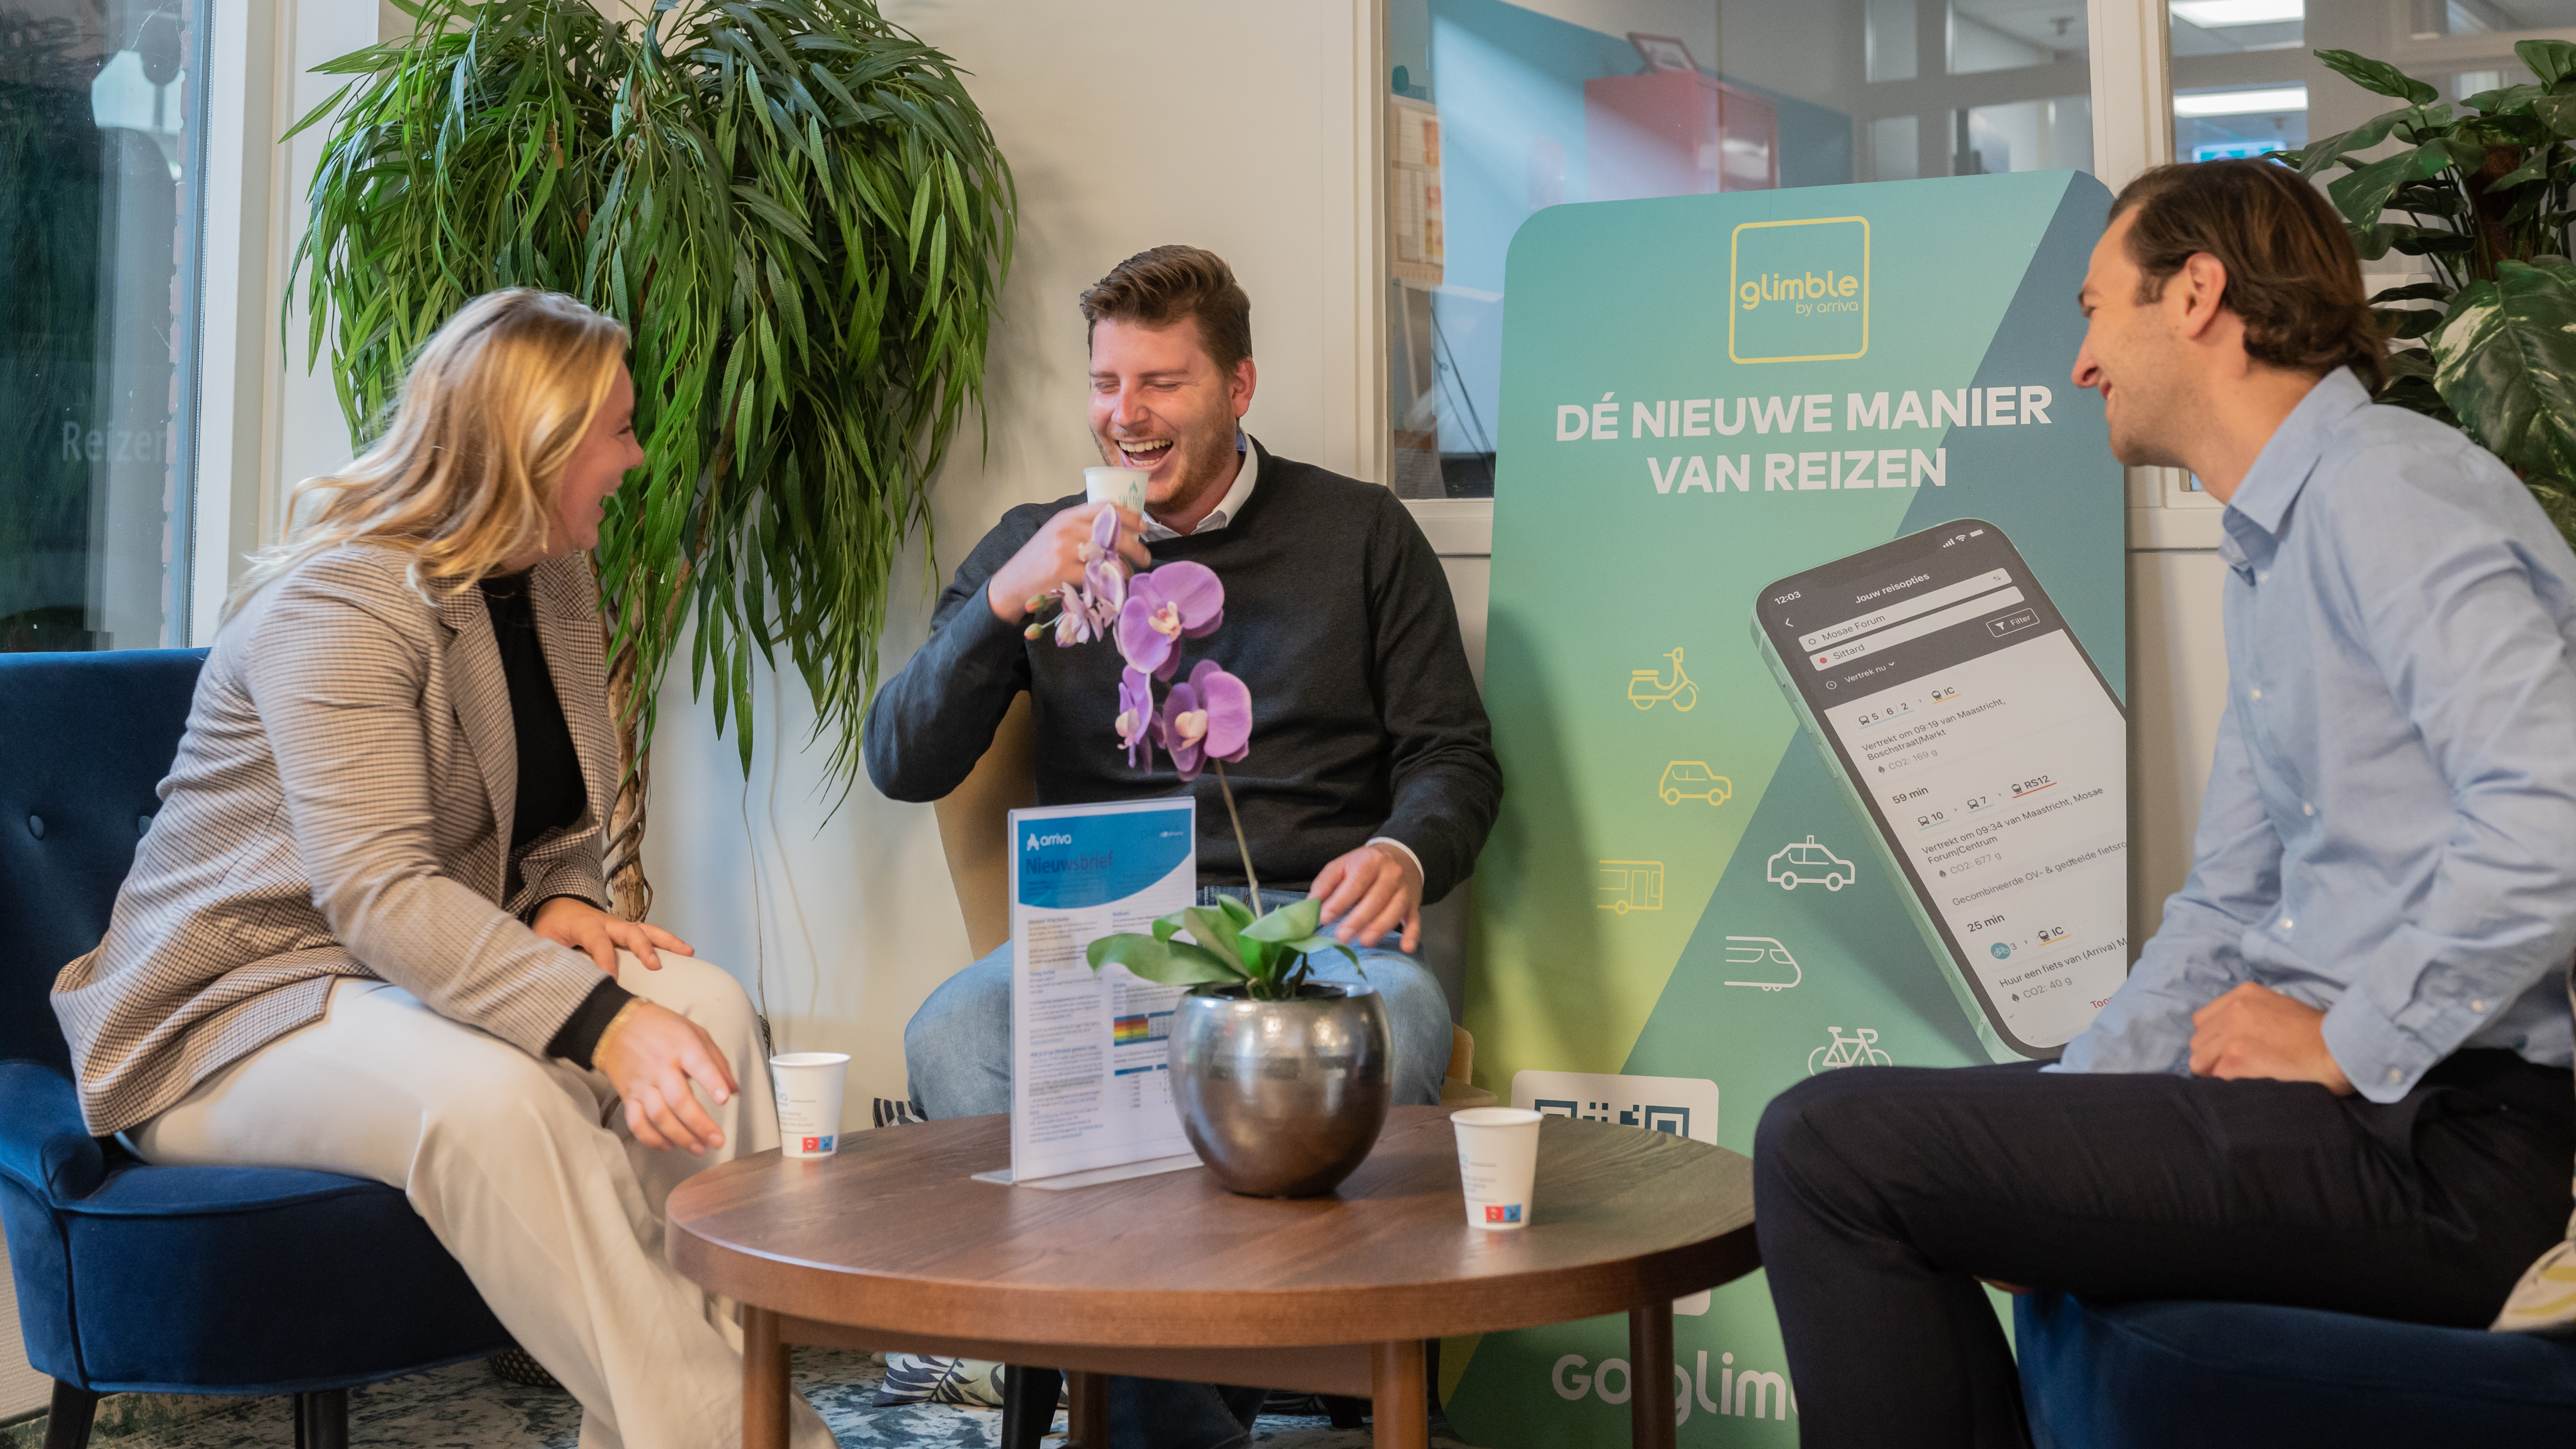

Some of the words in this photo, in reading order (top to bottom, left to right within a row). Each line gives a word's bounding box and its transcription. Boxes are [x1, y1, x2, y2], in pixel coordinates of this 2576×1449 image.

[1740, 271, 1859, 310] glimble
[1796, 302, 1813, 317] by
[1817, 300, 1859, 314] arriva
[1555, 392, 1620, 441] DÉ
[1632, 393, 1833, 438] NIEUWE
[1846, 385, 2053, 431] MANIER
[1647, 454, 1751, 494] VAN
[1764, 448, 1946, 491] REIZEN
[1774, 591, 1801, 605] 12:03
[1855, 588, 1881, 605] Jouw
[1882, 572, 1930, 594] reisopties
[1822, 626, 1854, 641] Mosae
[1857, 615, 1885, 630] Forum
[2010, 615, 2031, 626] Filter
[1833, 644, 1865, 660] Sittard
[1844, 668, 1875, 683] Vertrek
[1944, 687, 1955, 695] IC
[1862, 735, 1897, 751] Vertrekt
[1899, 730, 1913, 739] om
[1914, 720, 1939, 734] 09:19
[1940, 715, 1955, 726] van
[1957, 699, 2006, 719] Maastricht,
[1867, 729, 1946, 761] Boschstraat/Markt
[1889, 758, 1911, 769] CO2:
[1912, 751, 1929, 762] 169
[1932, 749, 1938, 757] g
[1893, 793, 1908, 804] 59
[1909, 786, 1929, 799] min
[1931, 811, 1944, 821] 10
[2024, 775, 2050, 790] RS12
[1921, 838, 1959, 854] Vertrekt
[1960, 832, 1975, 841] om
[1975, 821, 2003, 836] 09:34
[2004, 815, 2021, 826] van
[2022, 798, 2073, 820] Maastricht,
[2073, 786, 2103, 801] Mosae
[1040, 834, 1072, 846] arriva
[1928, 835, 1998, 864] Forum/Centrum
[1026, 850, 1114, 874] Nieuwsbrief
[1950, 863, 1974, 874] CO2:
[1975, 855, 1992, 866] 677
[1995, 852, 2001, 860] g
[1953, 877, 2024, 905] Gecombineerde
[2025, 871, 2043, 881] OV-
[2055, 852, 2097, 872] gedeelde
[1967, 921, 1983, 932] 25
[1984, 914, 2005, 926] min
[2052, 926, 2064, 936] IC
[1999, 975, 2022, 987] Huur
[2025, 968, 2042, 979] een
[2043, 960, 2063, 973] fiets
[2065, 955, 2081, 964] van
[2083, 942, 2117, 960] (Arriva)
[2023, 986, 2048, 998] CO2:
[2049, 979, 2062, 989] 40
[2065, 977, 2072, 985] g
[1552, 1354, 1632, 1404] GO
[1674, 1350, 1799, 1428] lim
